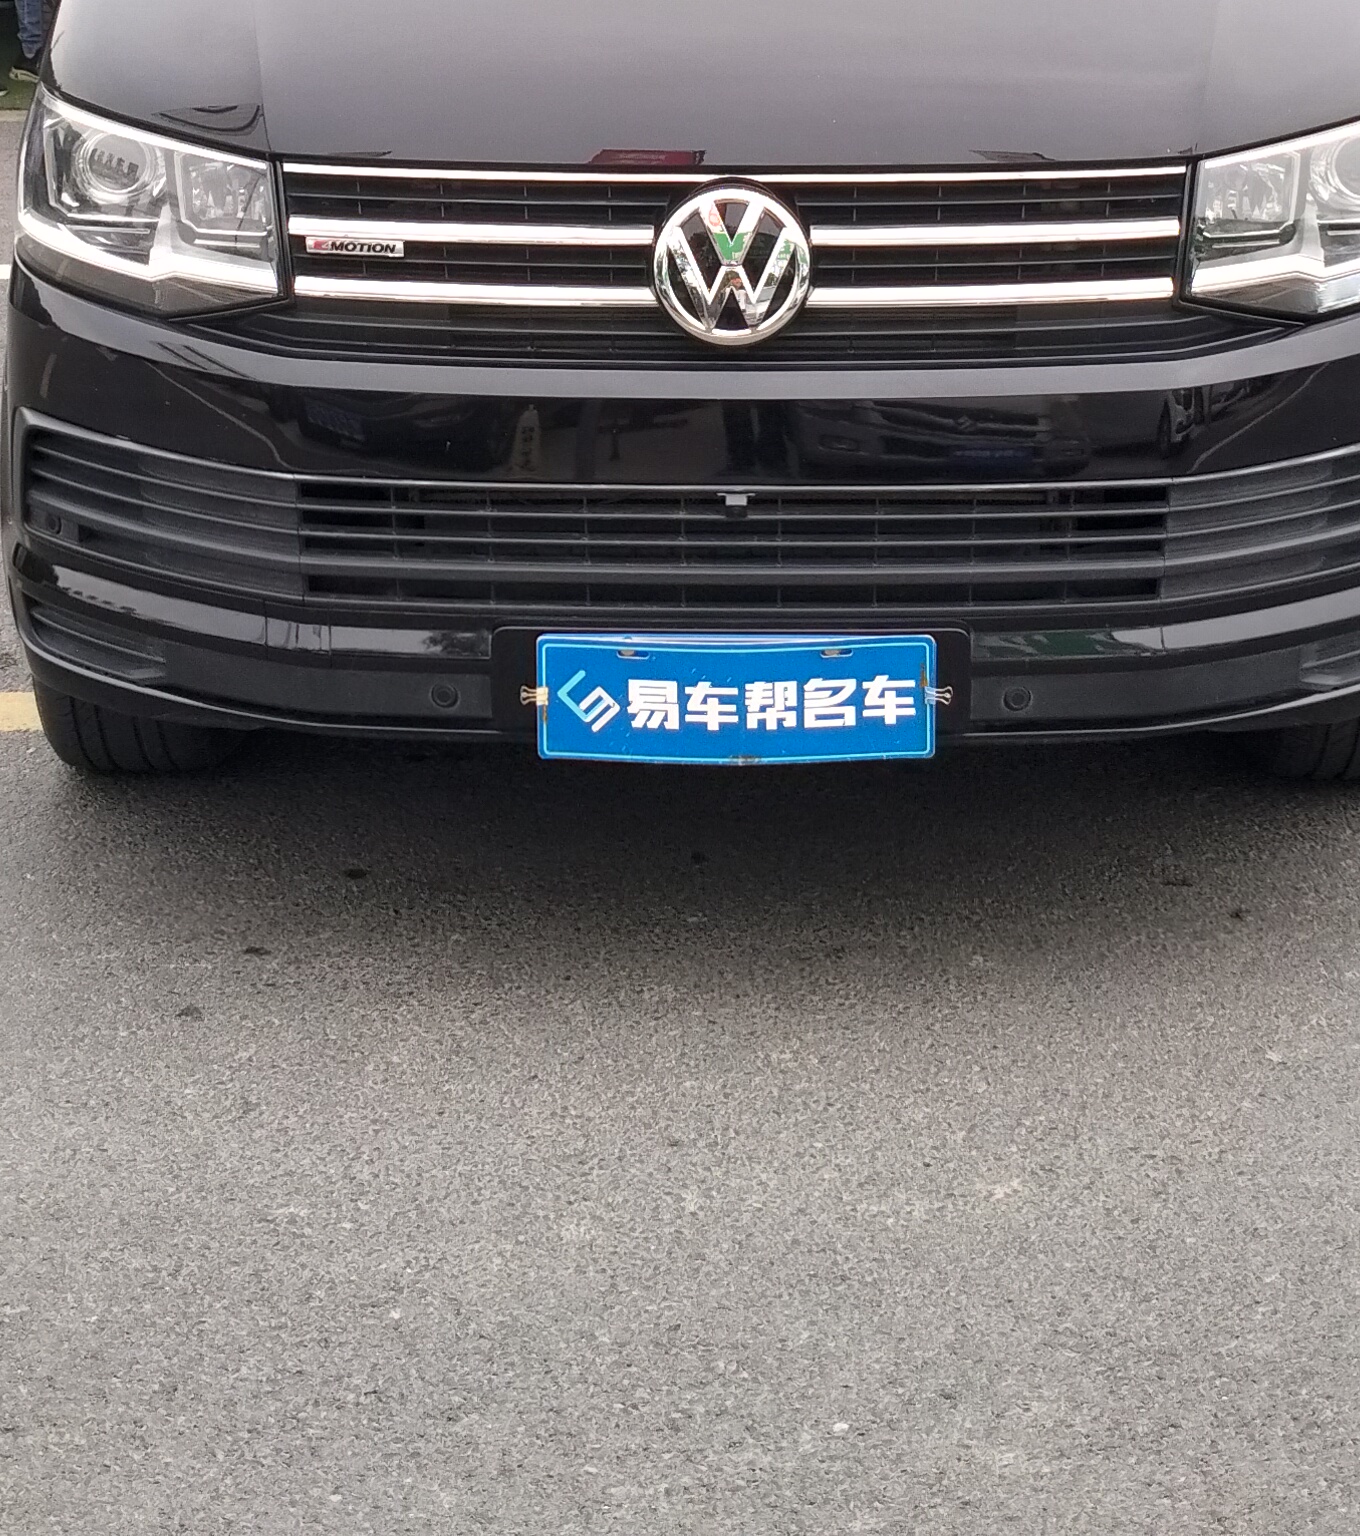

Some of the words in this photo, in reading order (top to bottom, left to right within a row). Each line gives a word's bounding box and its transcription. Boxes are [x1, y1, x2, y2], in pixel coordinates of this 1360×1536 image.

[313, 239, 397, 254] 4MOTION
[626, 675, 917, 731] 易车帮名车
